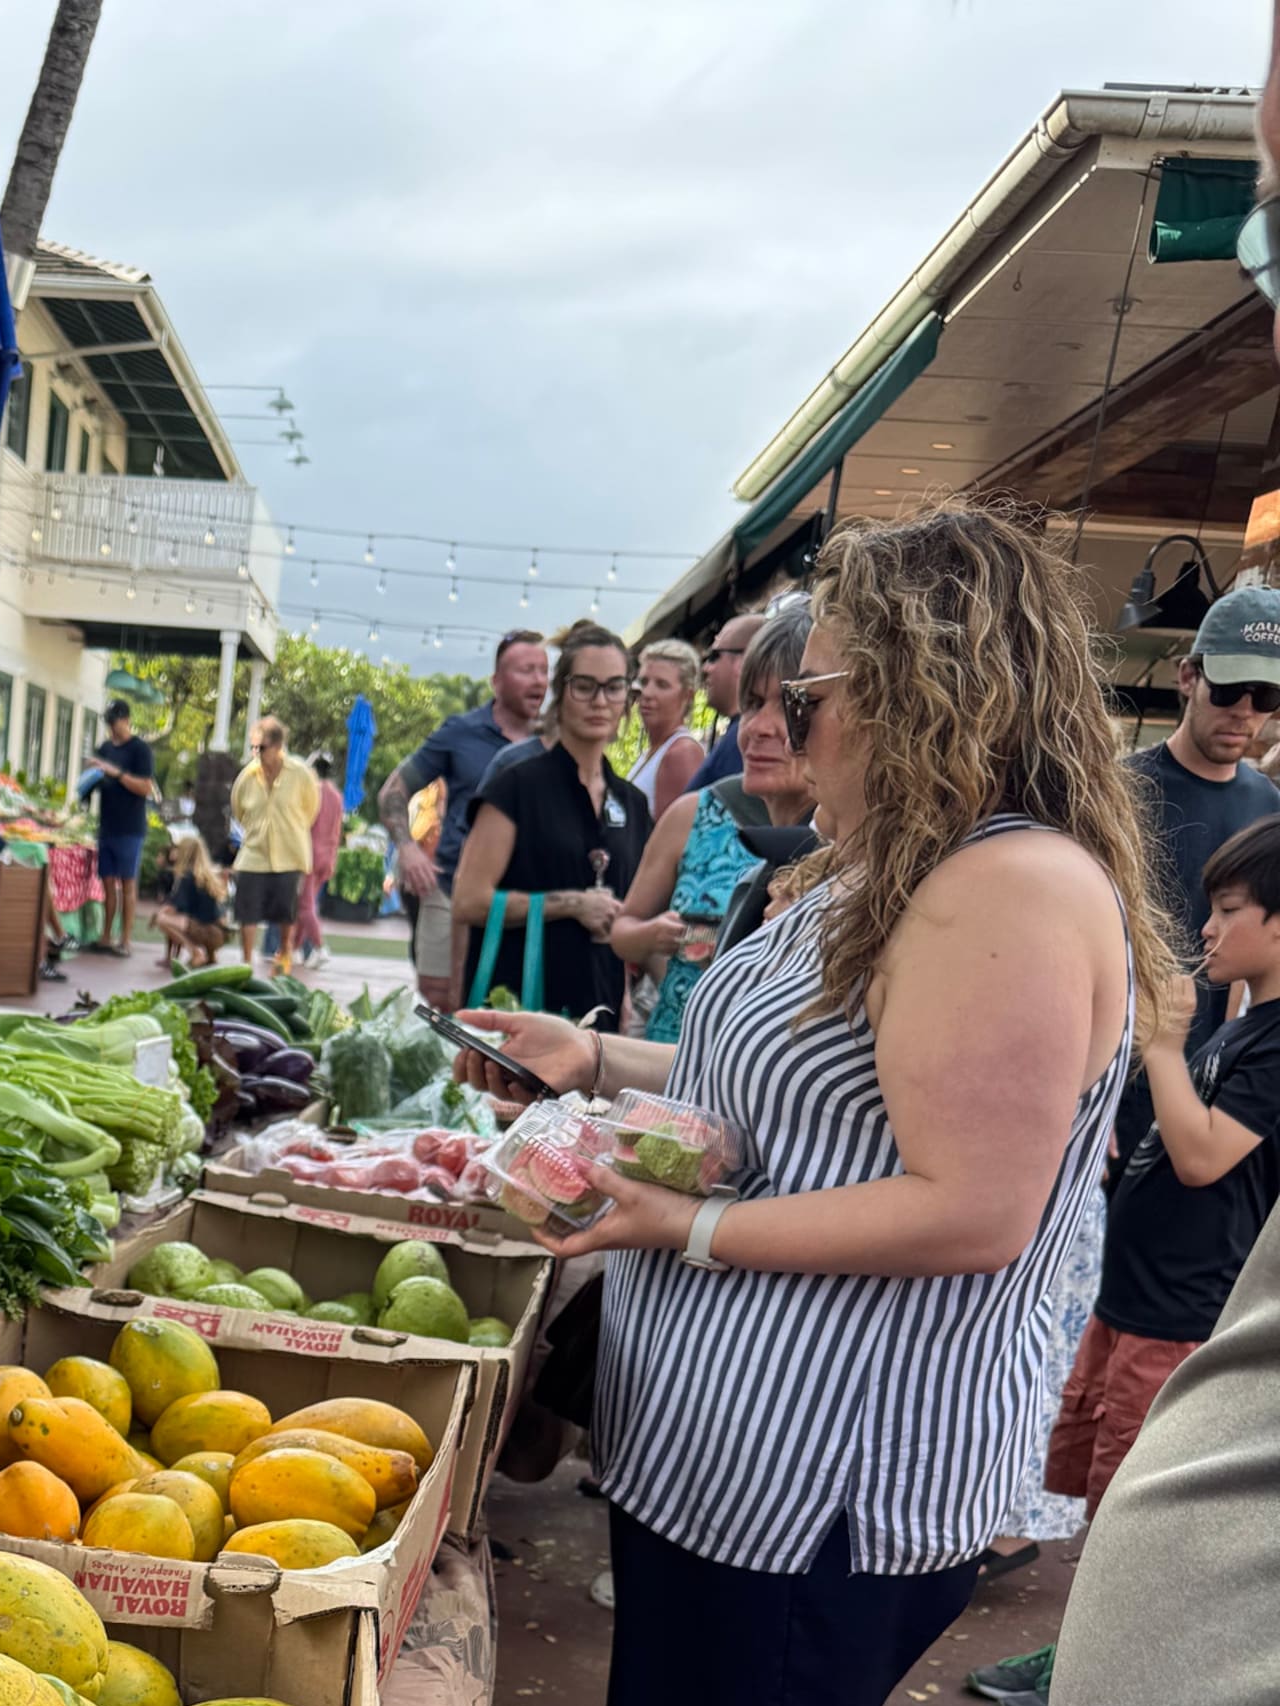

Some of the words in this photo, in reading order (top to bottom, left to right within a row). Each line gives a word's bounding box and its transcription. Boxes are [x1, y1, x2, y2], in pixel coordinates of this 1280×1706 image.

[1243, 622, 1280, 637] KAU
[251, 1322, 343, 1343] HAWAIIAN
[283, 1337, 341, 1354] ROYAL
[140, 1564, 192, 1581] Pineapple
[73, 1570, 190, 1598] HAWAIIAN
[112, 1595, 187, 1618] ROYAL
